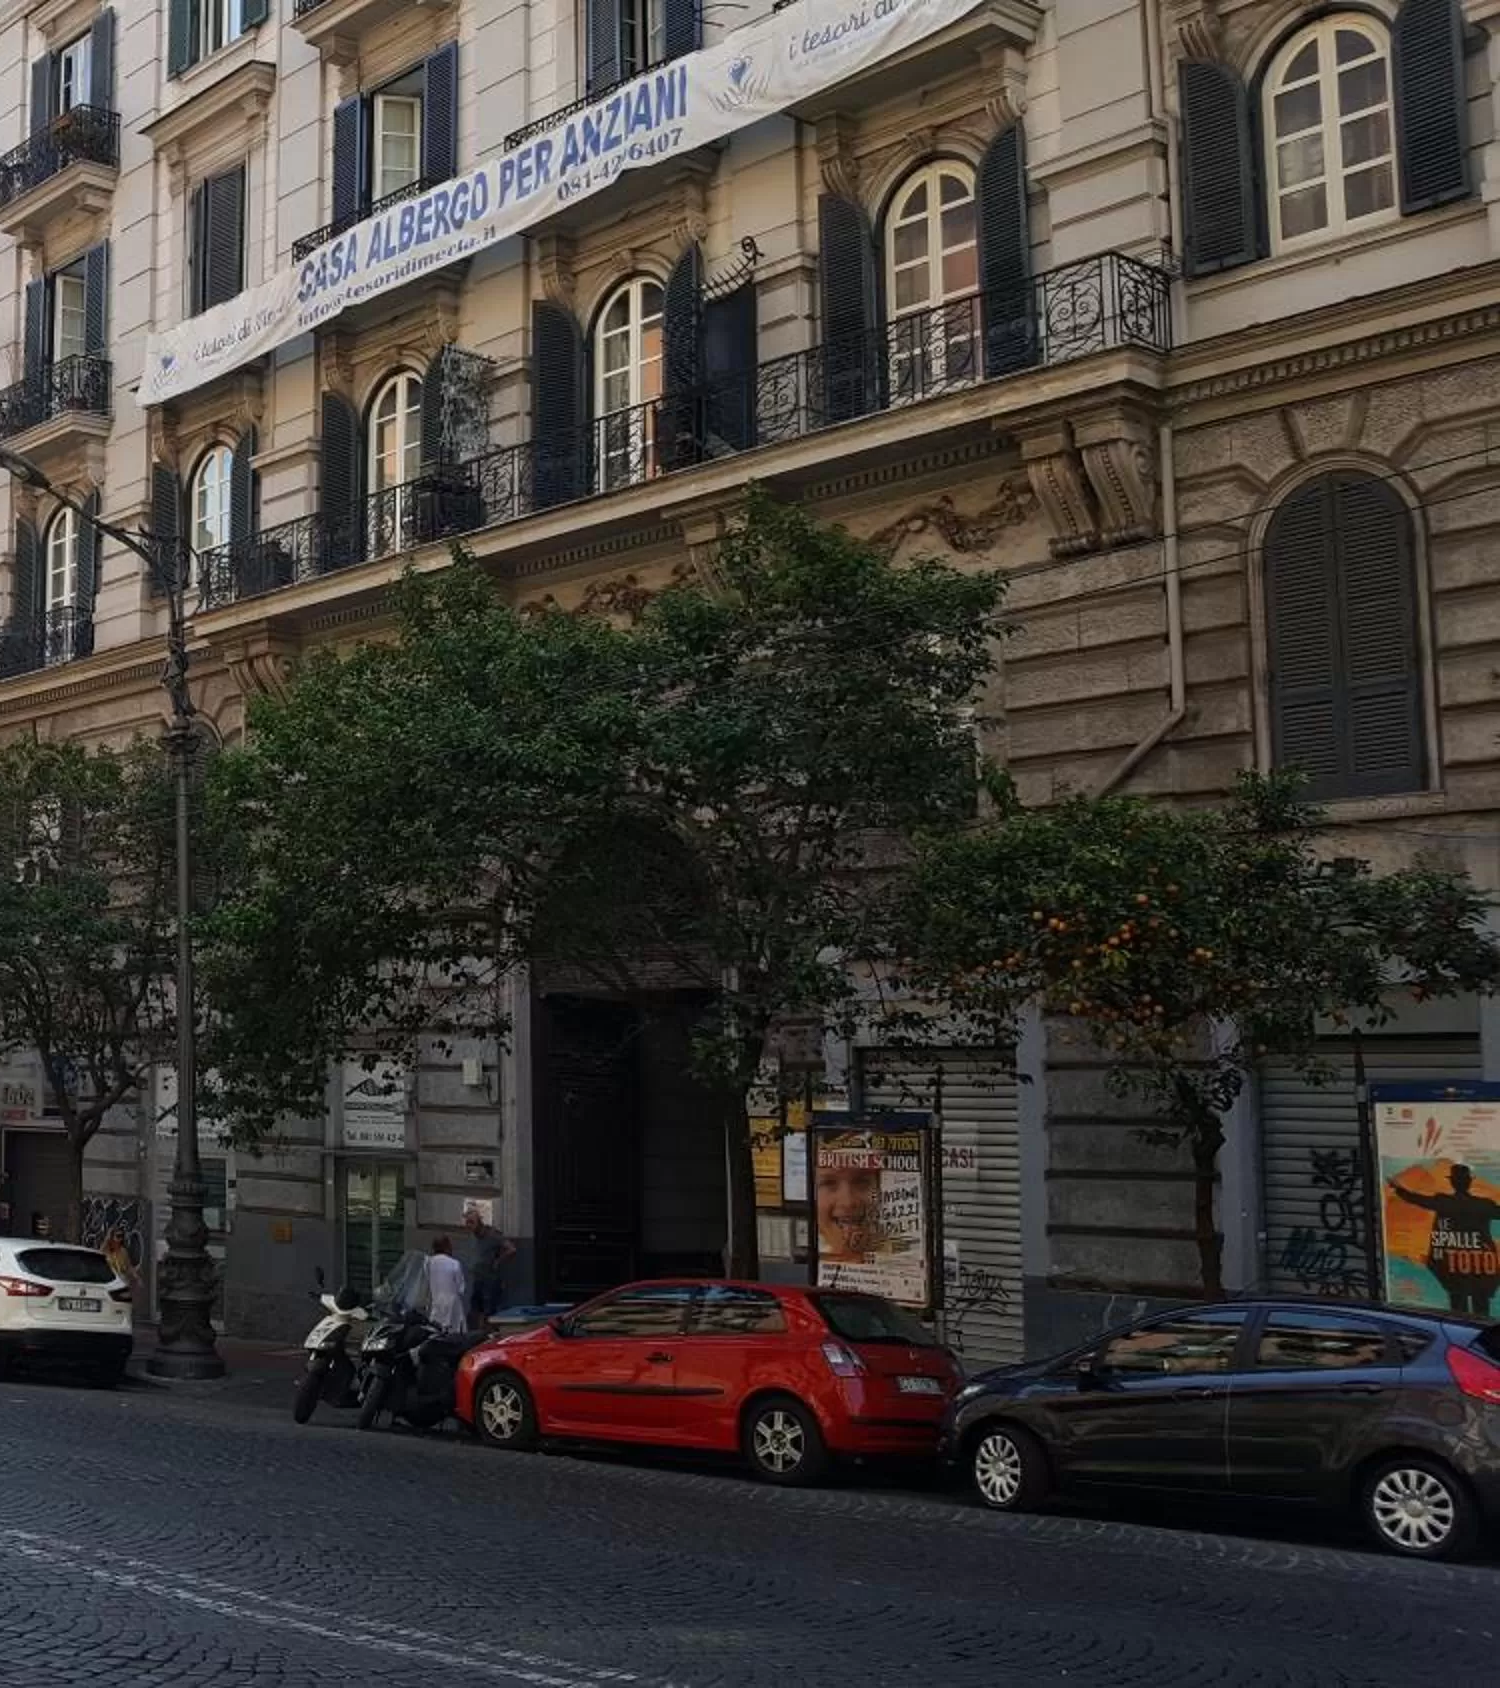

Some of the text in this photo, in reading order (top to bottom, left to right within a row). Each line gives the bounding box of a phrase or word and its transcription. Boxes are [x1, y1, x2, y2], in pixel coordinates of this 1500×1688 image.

[296, 64, 688, 303] CASA ALBERGO PER ANZIANI
[818, 1151, 920, 1171] BRITISH SCHOOL
[1431, 1231, 1482, 1249] SPALLE
